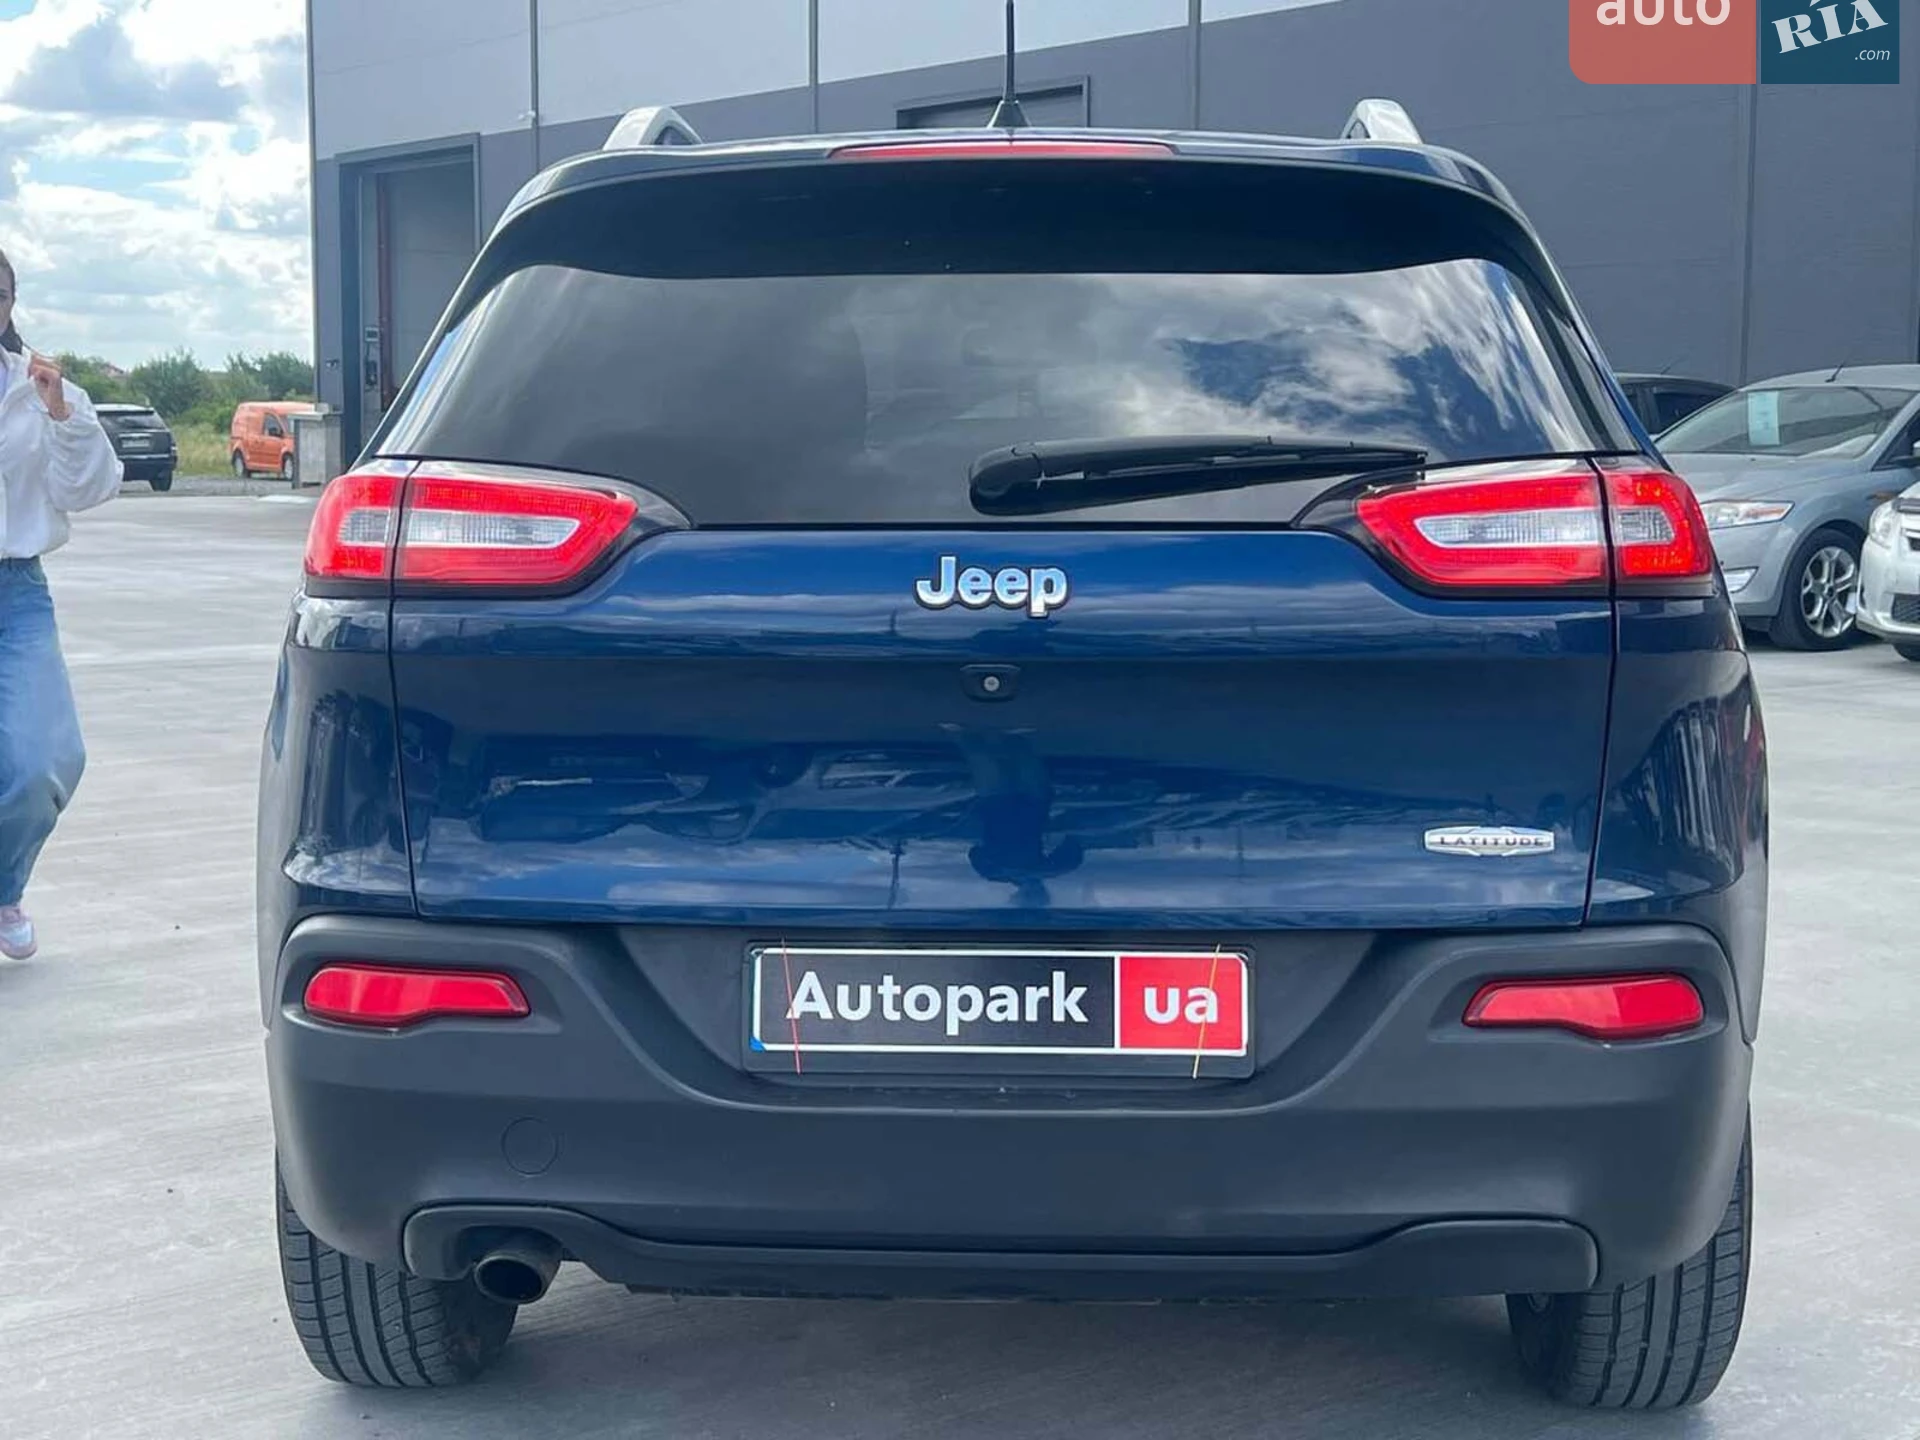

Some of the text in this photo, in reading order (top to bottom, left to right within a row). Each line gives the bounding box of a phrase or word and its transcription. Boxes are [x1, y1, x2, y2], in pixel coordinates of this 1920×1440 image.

[914, 555, 1069, 618] Jeep
[1439, 836, 1545, 847] LATITUDE
[785, 970, 1220, 1037] Autopark ua
